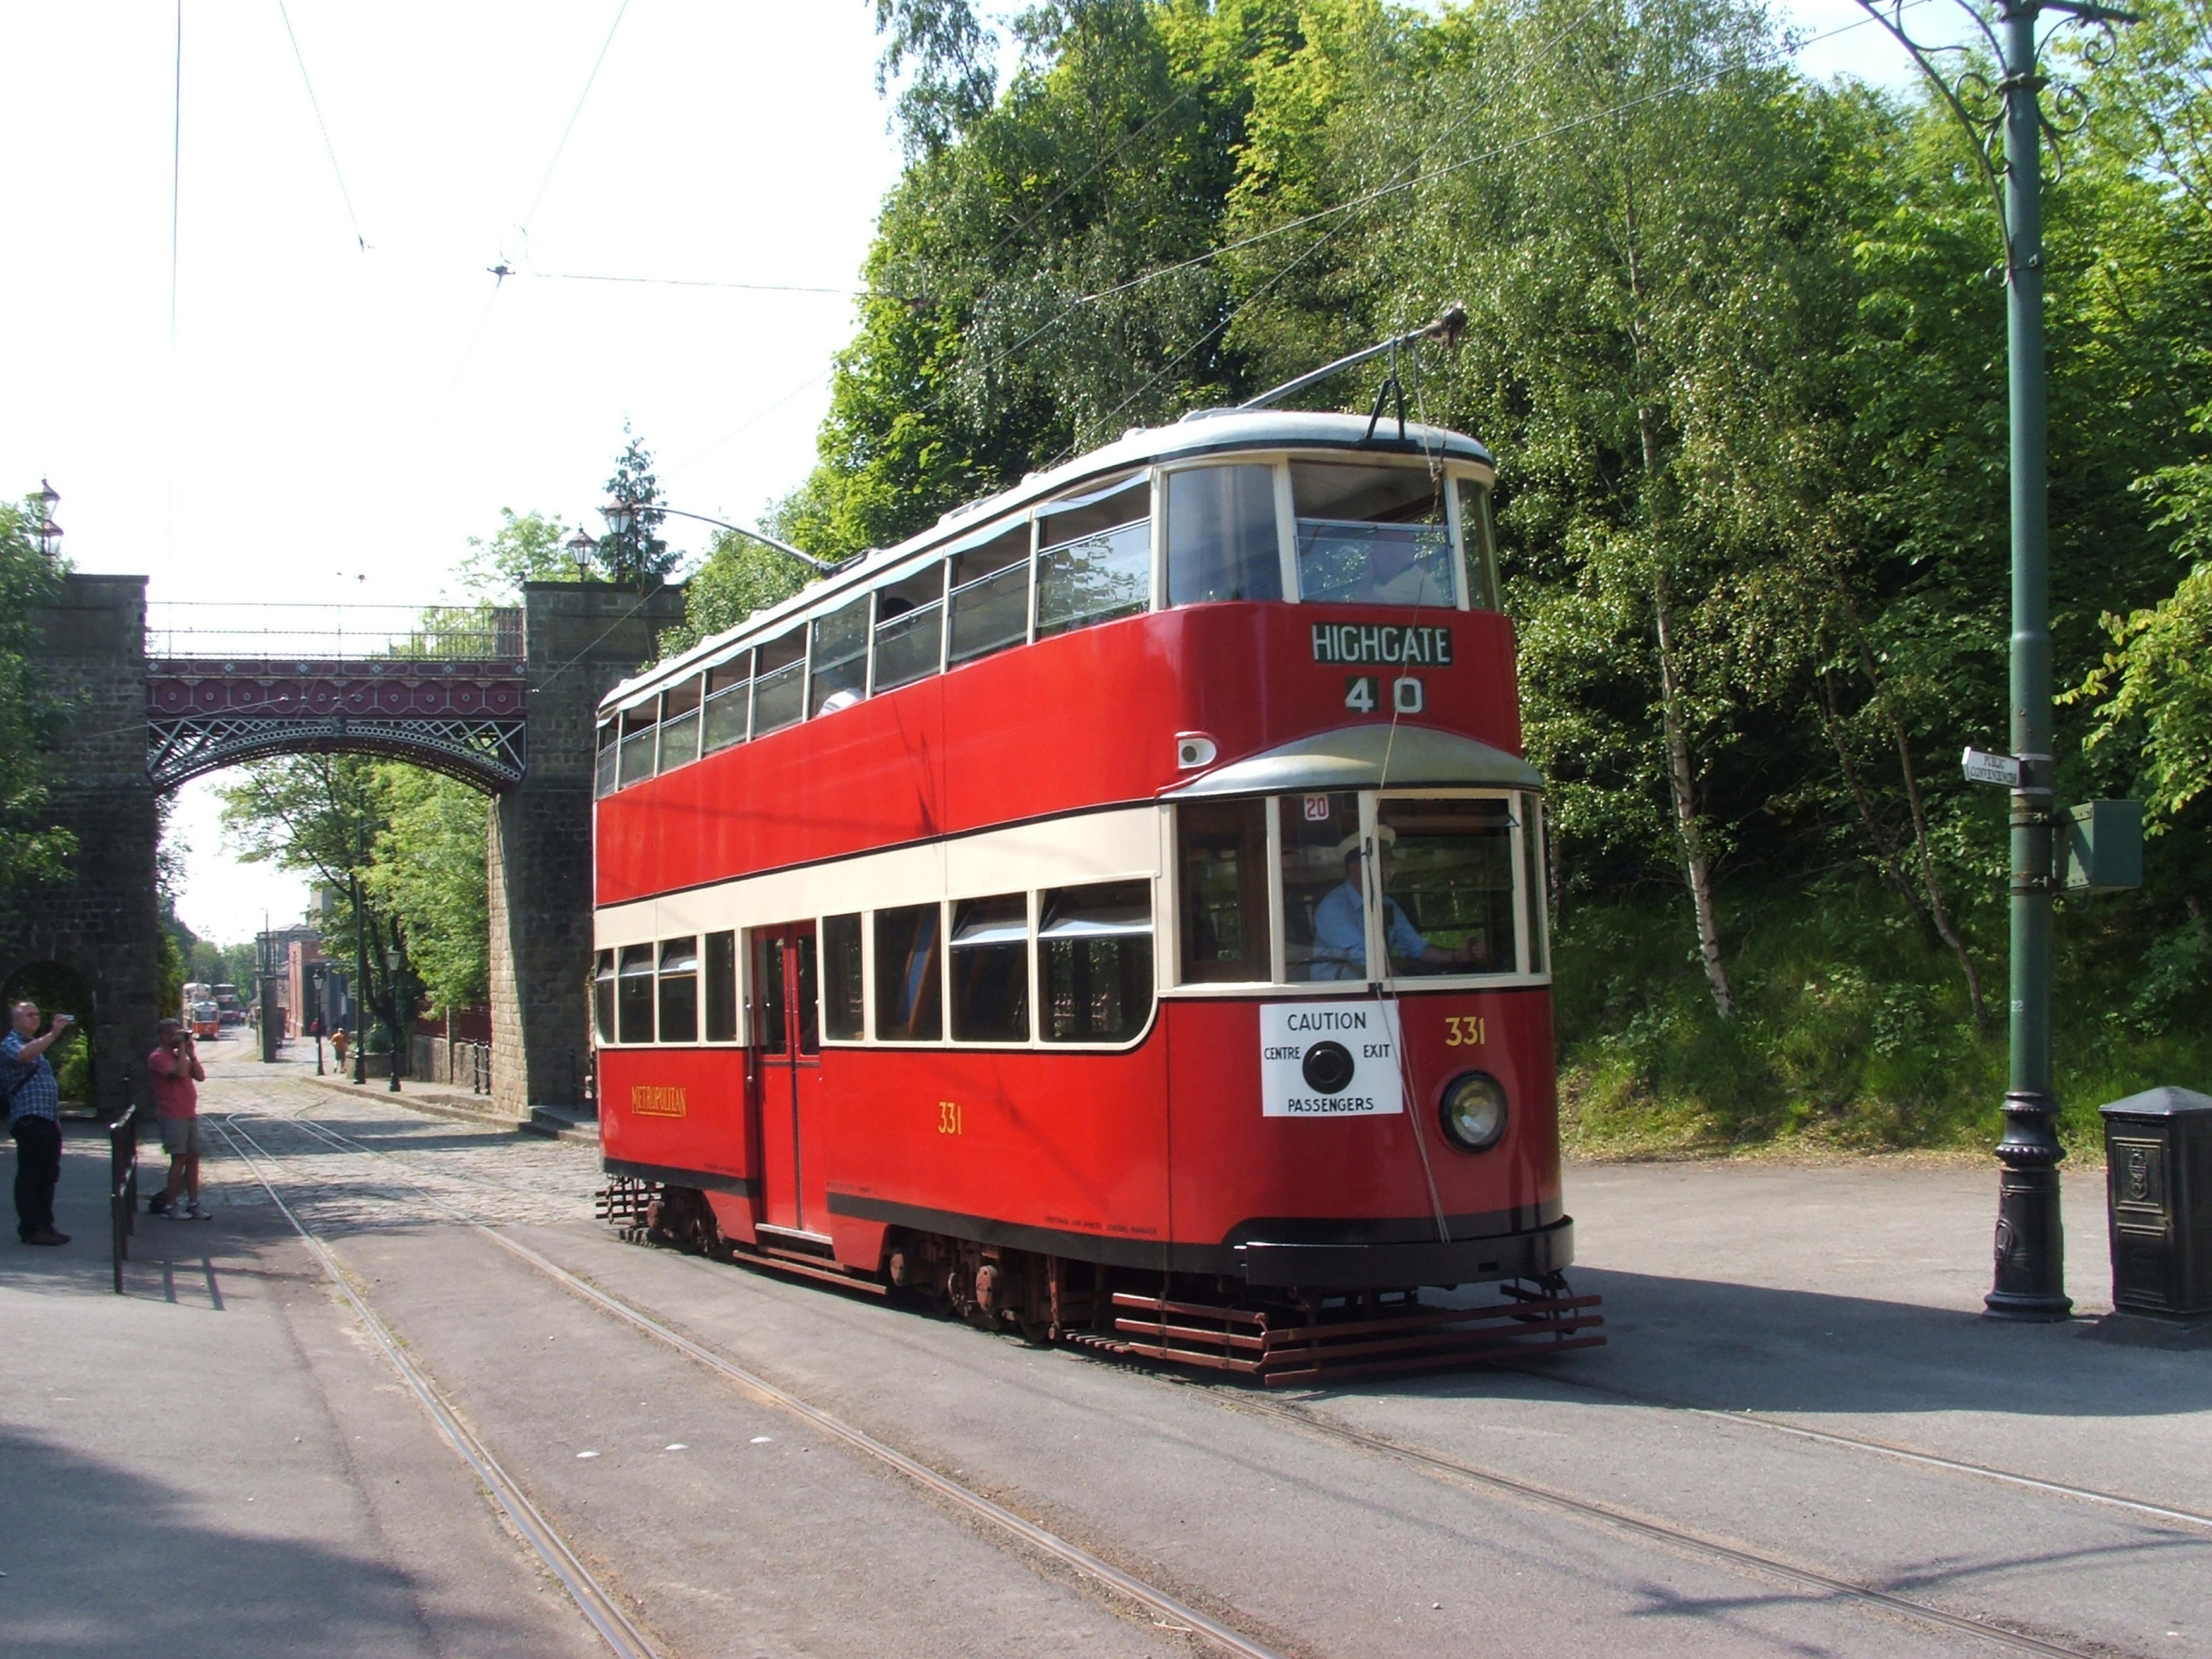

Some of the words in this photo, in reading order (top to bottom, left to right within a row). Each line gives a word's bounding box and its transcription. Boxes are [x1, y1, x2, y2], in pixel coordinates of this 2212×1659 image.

[1312, 624, 1450, 662] HIGHGATE
[1307, 798, 1327, 818] 20
[1287, 1012, 1366, 1031] CAUTION
[1445, 1016, 1485, 1047] 331
[1264, 1047, 1301, 1060] CENTRE
[1363, 1044, 1389, 1058] EXIT
[632, 1086, 686, 1117] METROPOLITAN
[1289, 1098, 1374, 1112] PASSENGERS
[938, 1102, 961, 1135] 331
